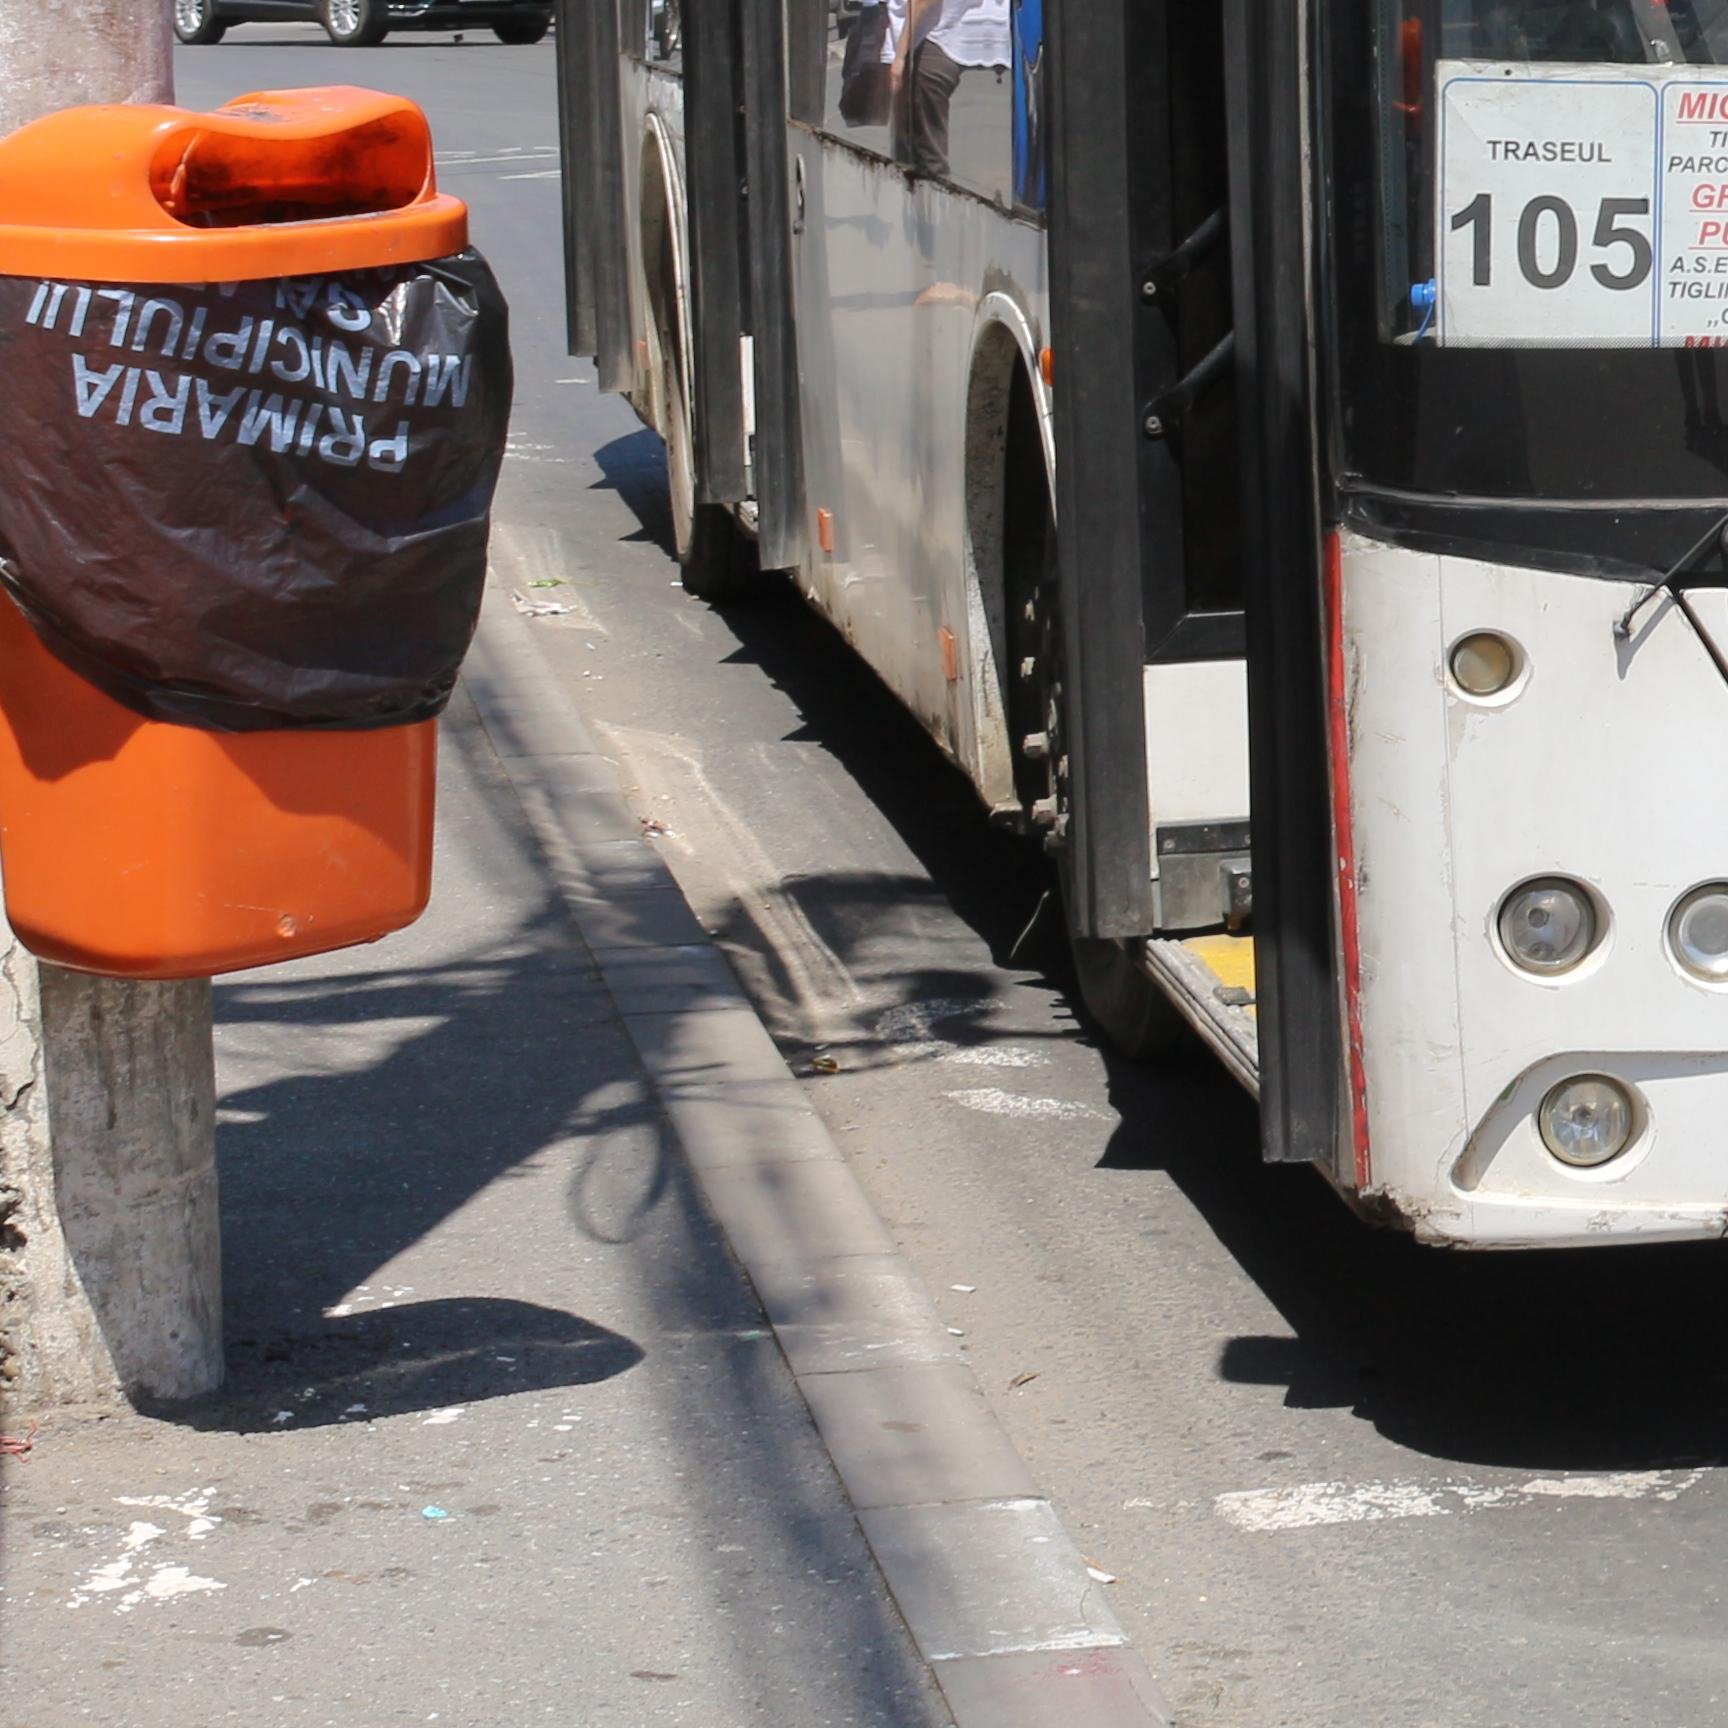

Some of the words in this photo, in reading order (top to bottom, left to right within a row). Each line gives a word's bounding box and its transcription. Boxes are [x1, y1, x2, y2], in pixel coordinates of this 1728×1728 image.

[1488, 140, 1612, 163] TRASEUL
[1450, 193, 1654, 290] 105
[25, 280, 471, 409] MUNICIPIULUI
[72, 352, 409, 475] PRIMARIA
